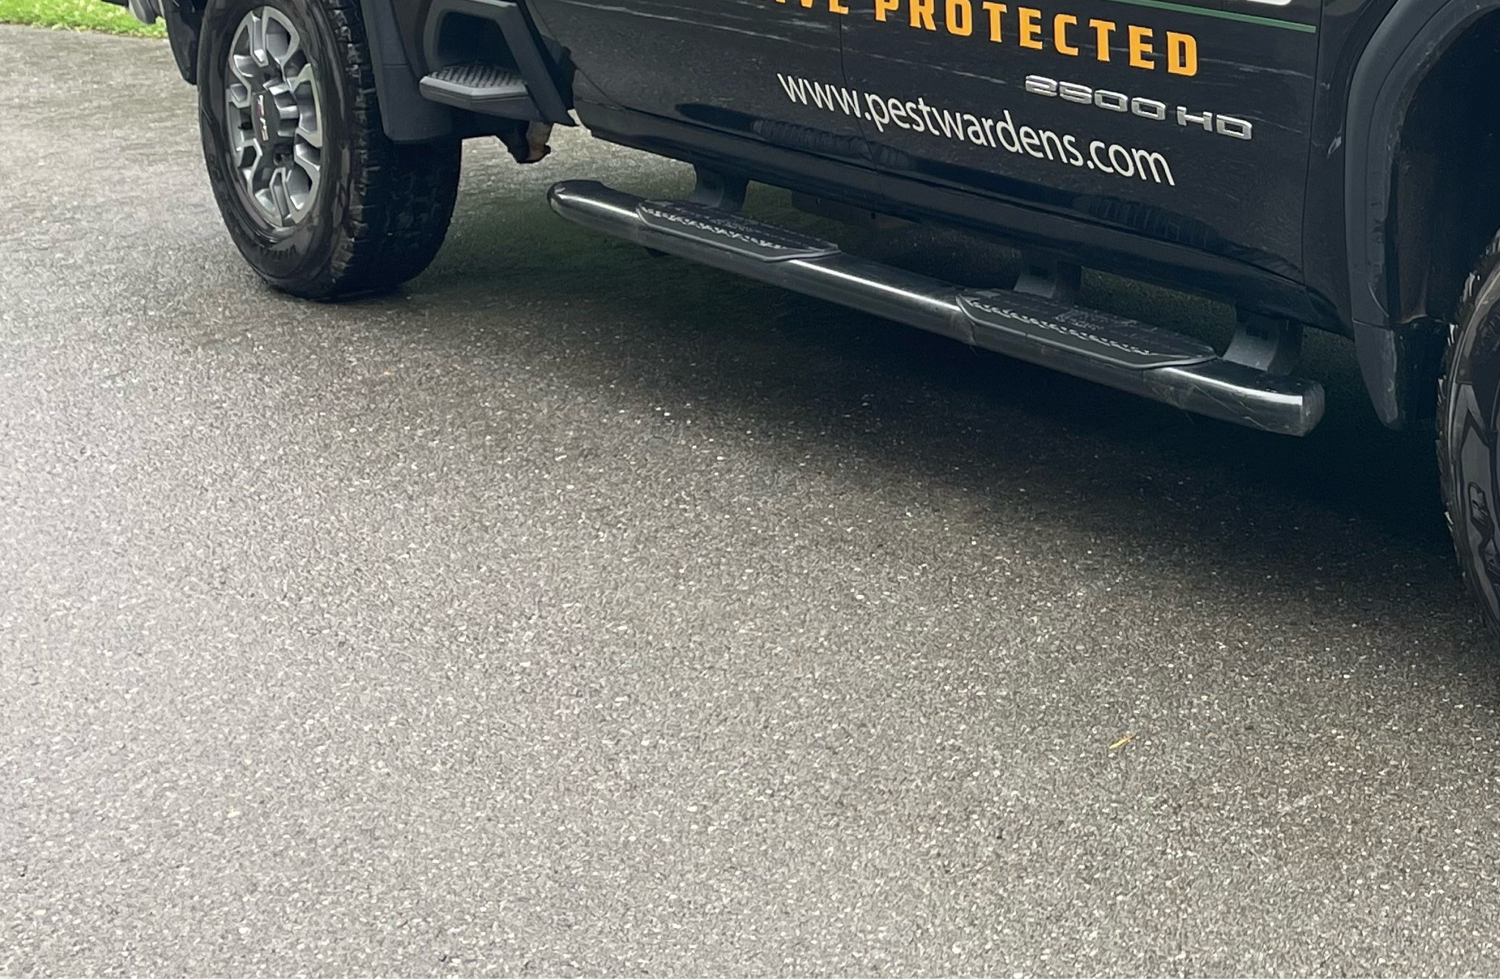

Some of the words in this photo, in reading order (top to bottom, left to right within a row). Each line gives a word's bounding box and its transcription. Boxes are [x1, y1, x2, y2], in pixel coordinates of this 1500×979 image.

[777, 72, 1175, 187] www.pestwardens.com
[1025, 74, 1166, 121] 2500
[1176, 106, 1252, 140] HD
